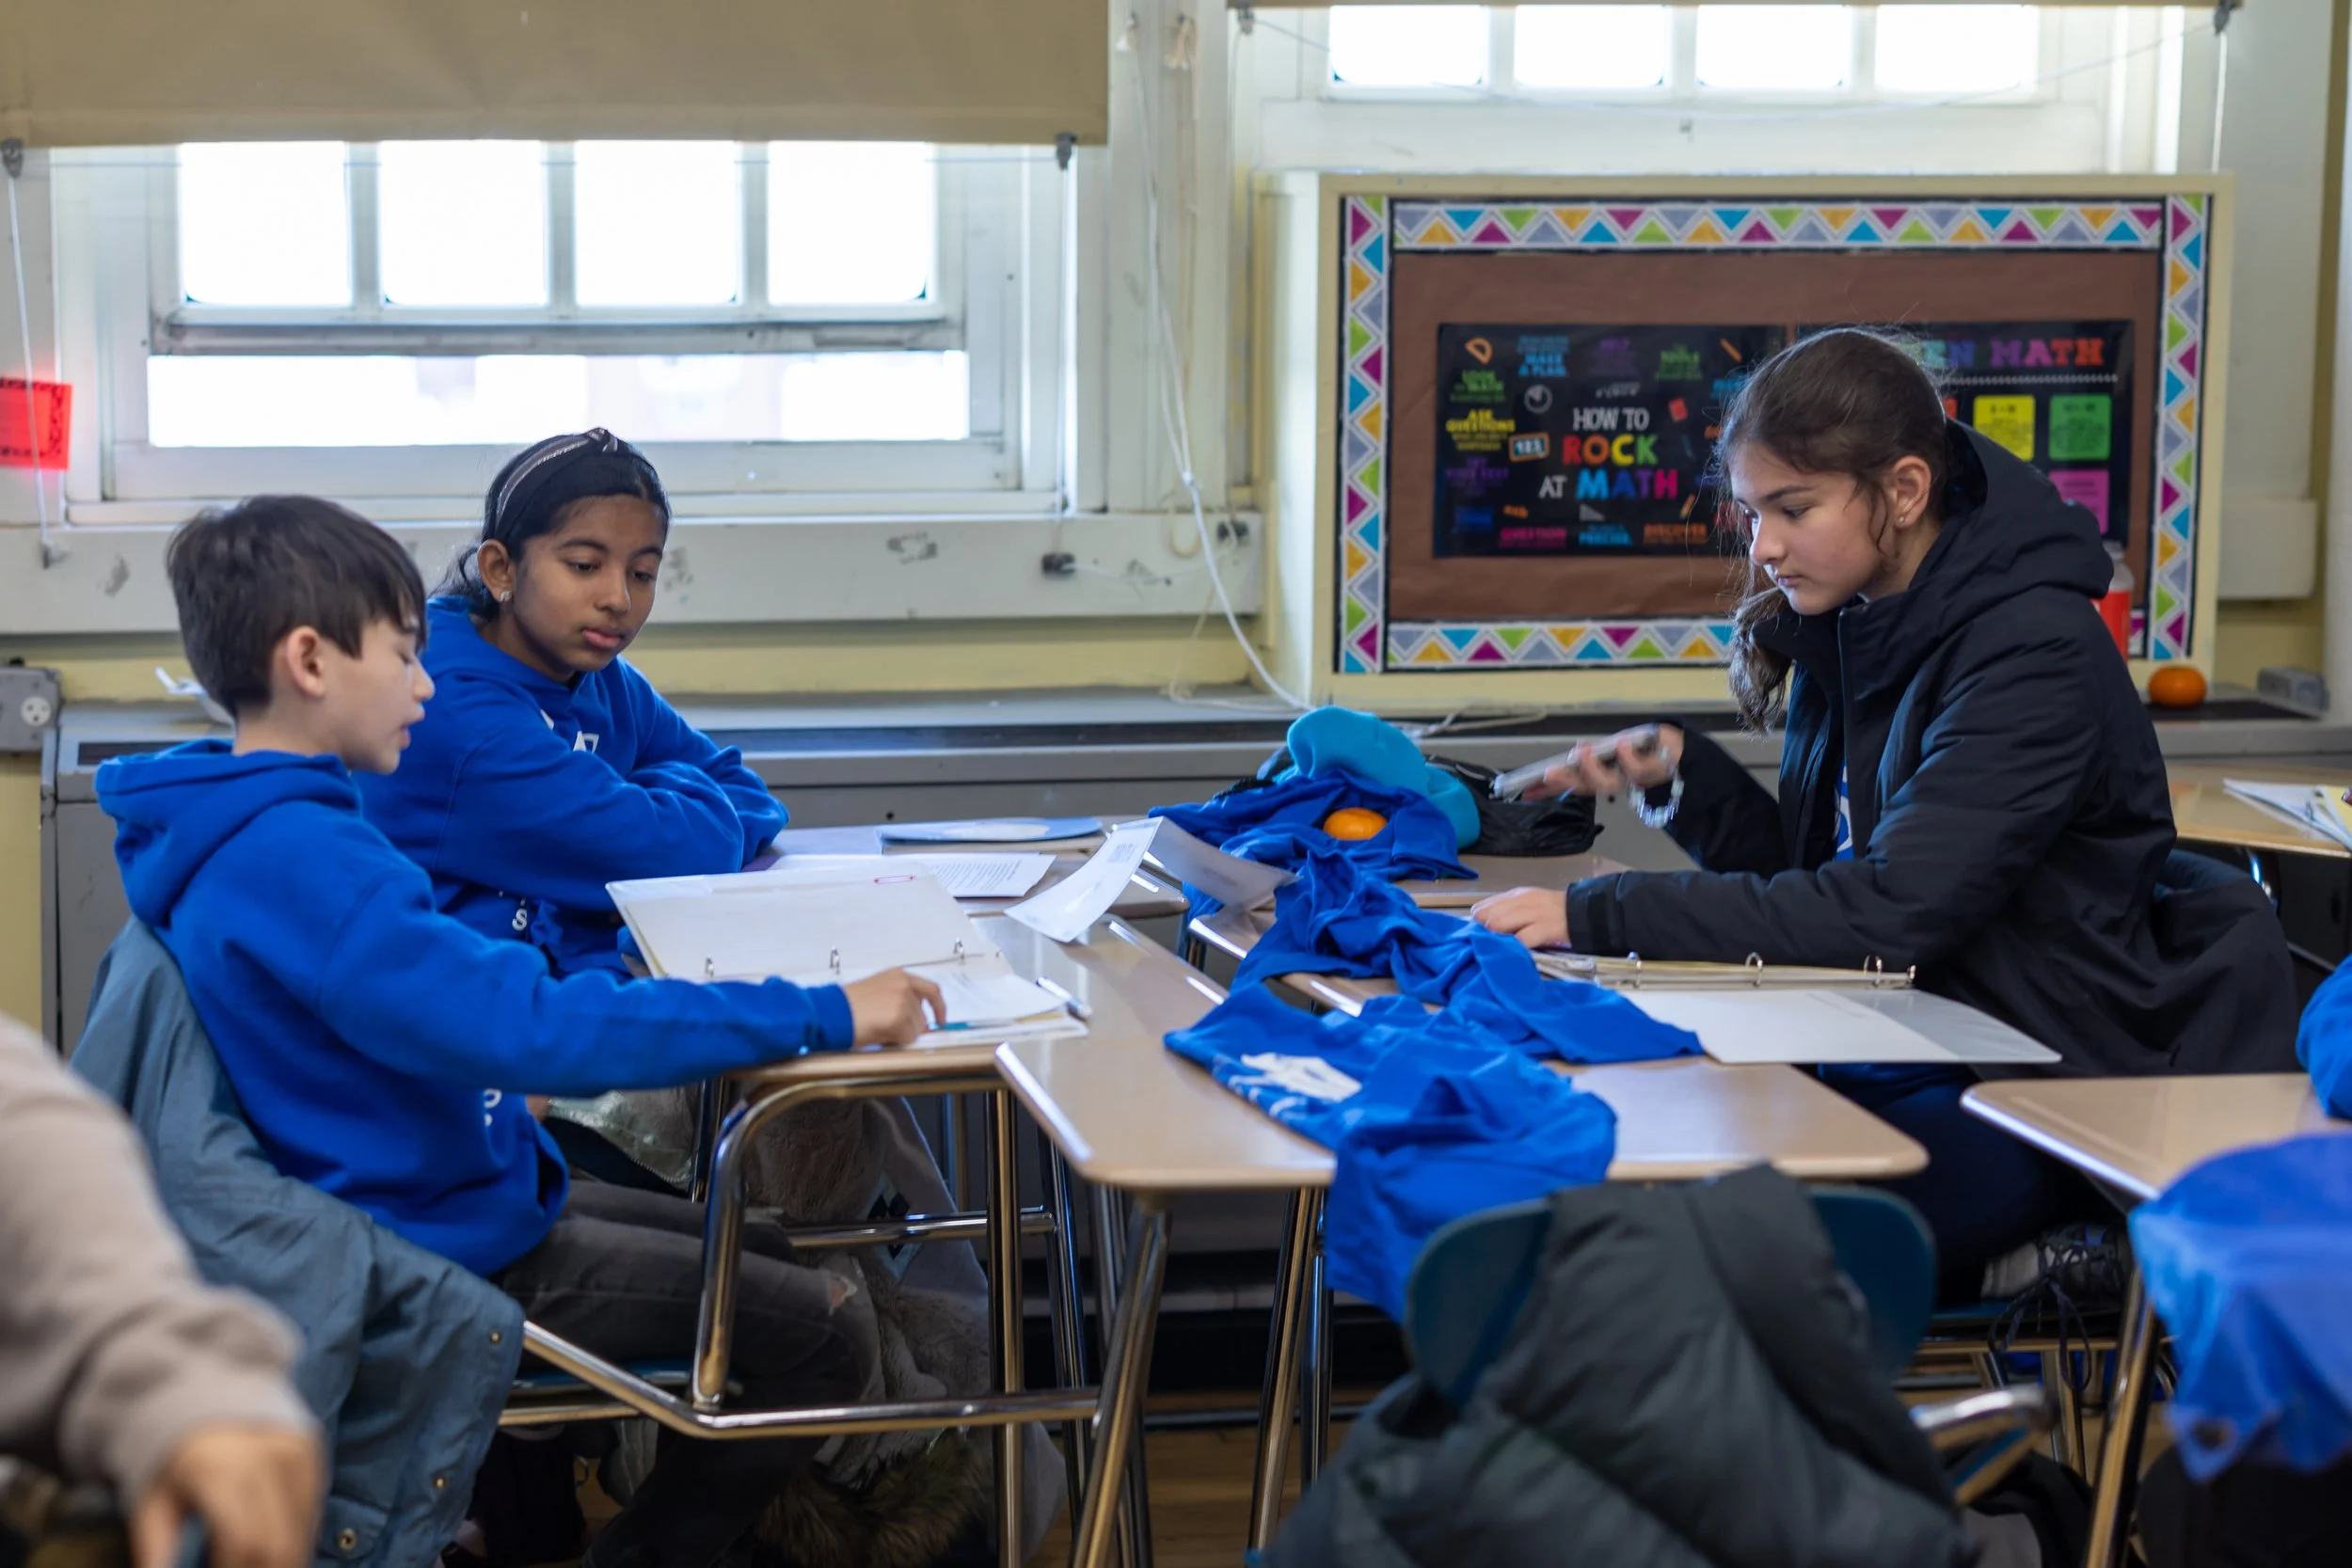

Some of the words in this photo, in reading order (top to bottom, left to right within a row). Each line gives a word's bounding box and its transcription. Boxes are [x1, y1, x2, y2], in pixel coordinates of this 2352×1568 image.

[1990, 339, 2105, 366] MATH
[1573, 407, 1619, 431] HOW
[1622, 407, 1650, 431] TO
[1562, 434, 1659, 466] ROCK
[1538, 475, 1567, 499] AT
[1575, 467, 1678, 500] MATH
